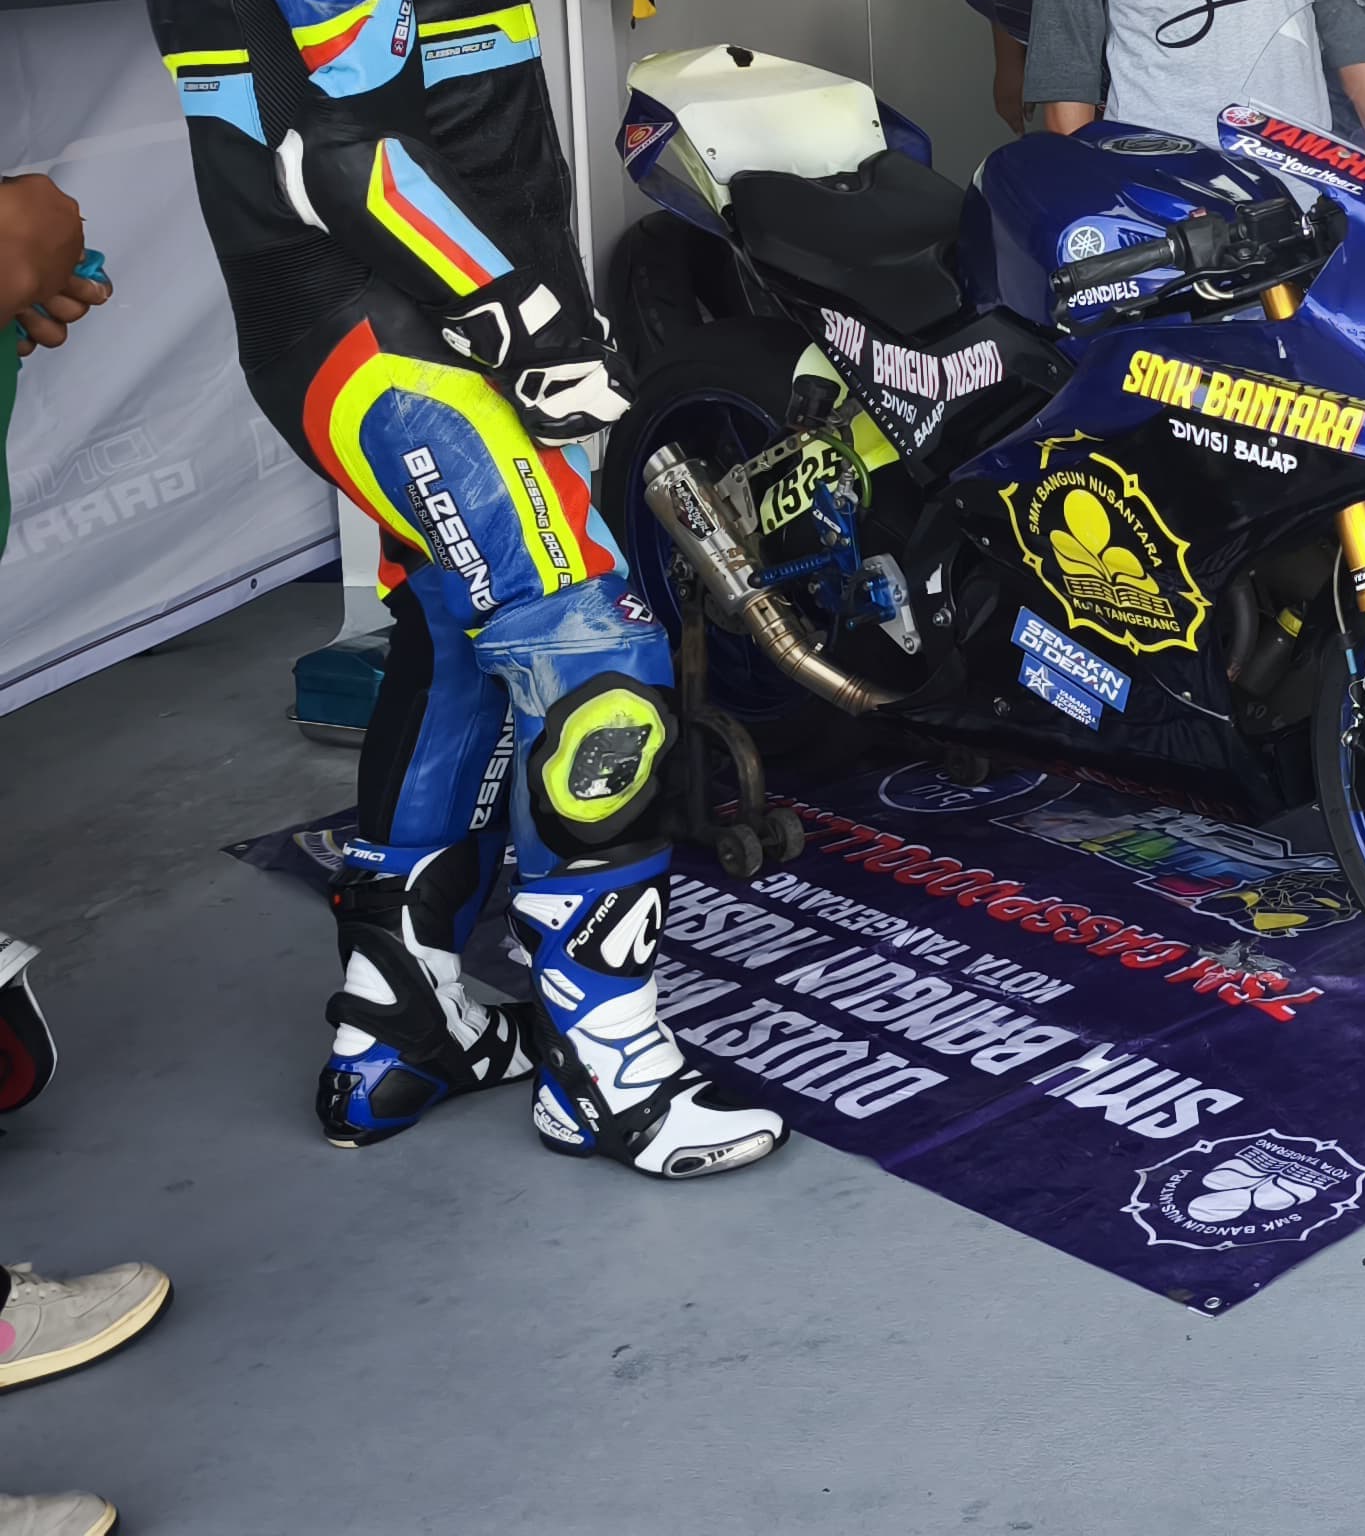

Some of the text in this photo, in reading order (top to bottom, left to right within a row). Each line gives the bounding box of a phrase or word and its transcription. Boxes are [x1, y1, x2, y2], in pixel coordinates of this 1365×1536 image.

[821, 307, 939, 401] SMK BANGUN
[1122, 348, 1203, 410] SMK
[881, 389, 947, 449] DIVISI BALAP
[1168, 418, 1299, 475] DIVISI BALAP
[407, 484, 454, 571] RACE SUIT PRODUCT
[513, 458, 568, 568] BLESSING RACE
[1027, 469, 1164, 569] SMK BANGUN NUSANTARA
[1104, 605, 1182, 634] TANGERANG
[1040, 643, 1119, 702] DEPAN
[750, 872, 1076, 1004] KOTA TANGERANG
[674, 996, 949, 1120] DIVISI
[776, 945, 1243, 1140] SMK BANGUN
[1255, 1137, 1352, 1182] KOTA TANGERANG
[1183, 1216, 1257, 1237] BANGUN
[1260, 1210, 1302, 1234] SMK
